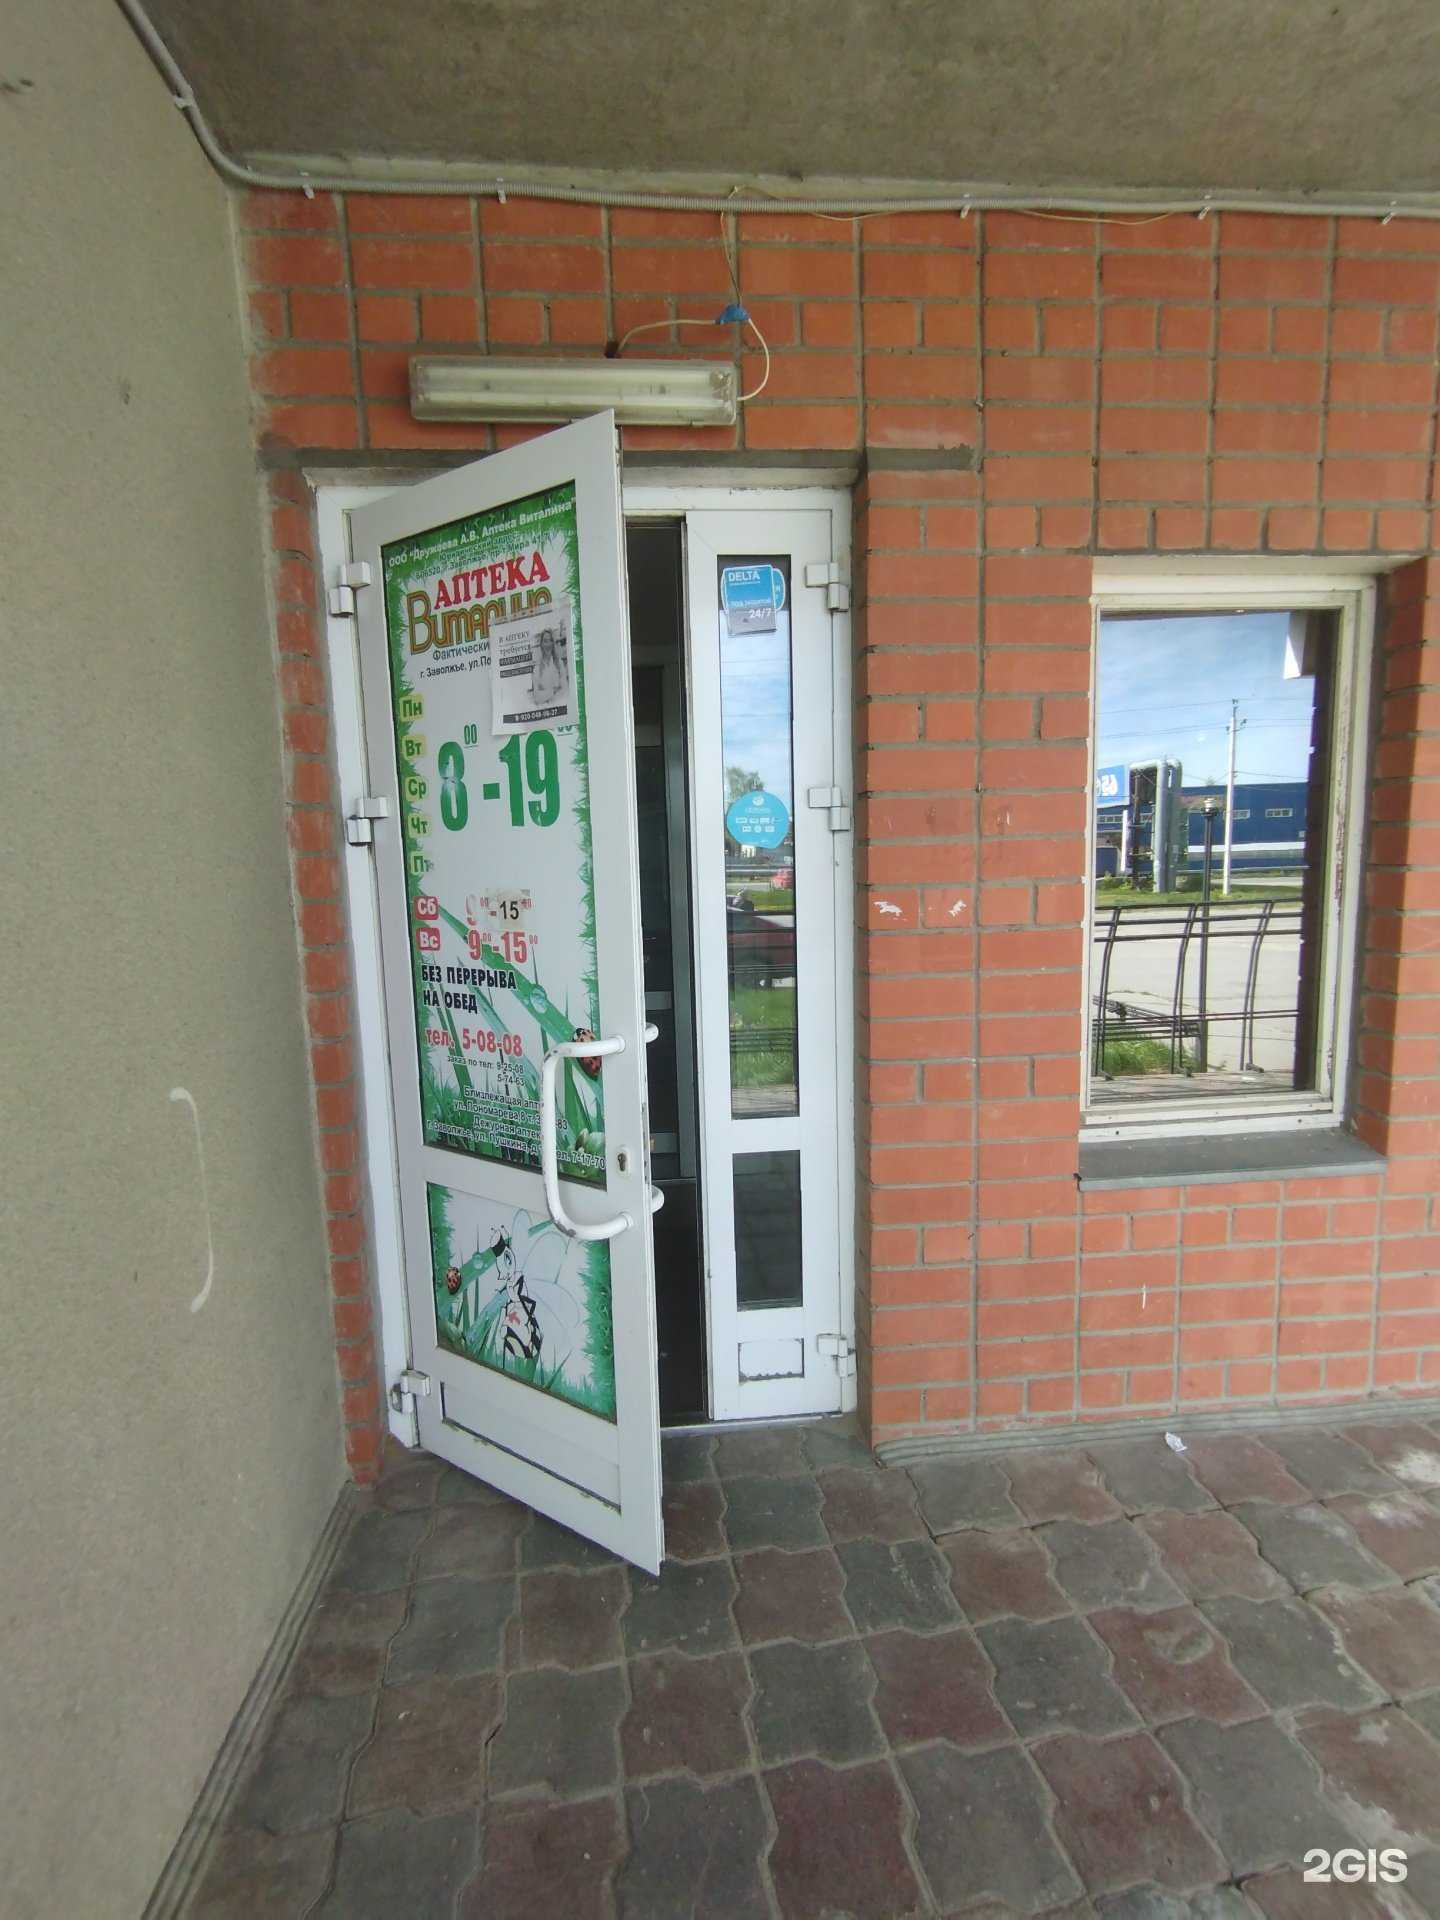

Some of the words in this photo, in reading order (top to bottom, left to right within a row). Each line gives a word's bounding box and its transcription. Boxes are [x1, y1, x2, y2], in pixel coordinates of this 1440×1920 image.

[481, 519, 517, 538] Аптека
[434, 550, 551, 610] АПТЕКА
[728, 570, 761, 582] DELTA
[748, 607, 772, 620] 24/7
[402, 700, 422, 717] Пн
[405, 740, 421, 757] Вт
[408, 778, 427, 800] Ср
[411, 817, 429, 835] Чт
[417, 898, 437, 916] Сб
[420, 932, 439, 950] Вс
[421, 964, 442, 983] БЕЗ
[446, 966, 517, 990] ПЕРЕРЫВА
[423, 989, 441, 1008] НА
[444, 991, 478, 1015] ОБЕД
[462, 1028, 523, 1058] 5-08-08
[468, 1058, 478, 1067] по
[464, 1086, 522, 1106] Близлежащая
[473, 1116, 516, 1134] Дежурная
